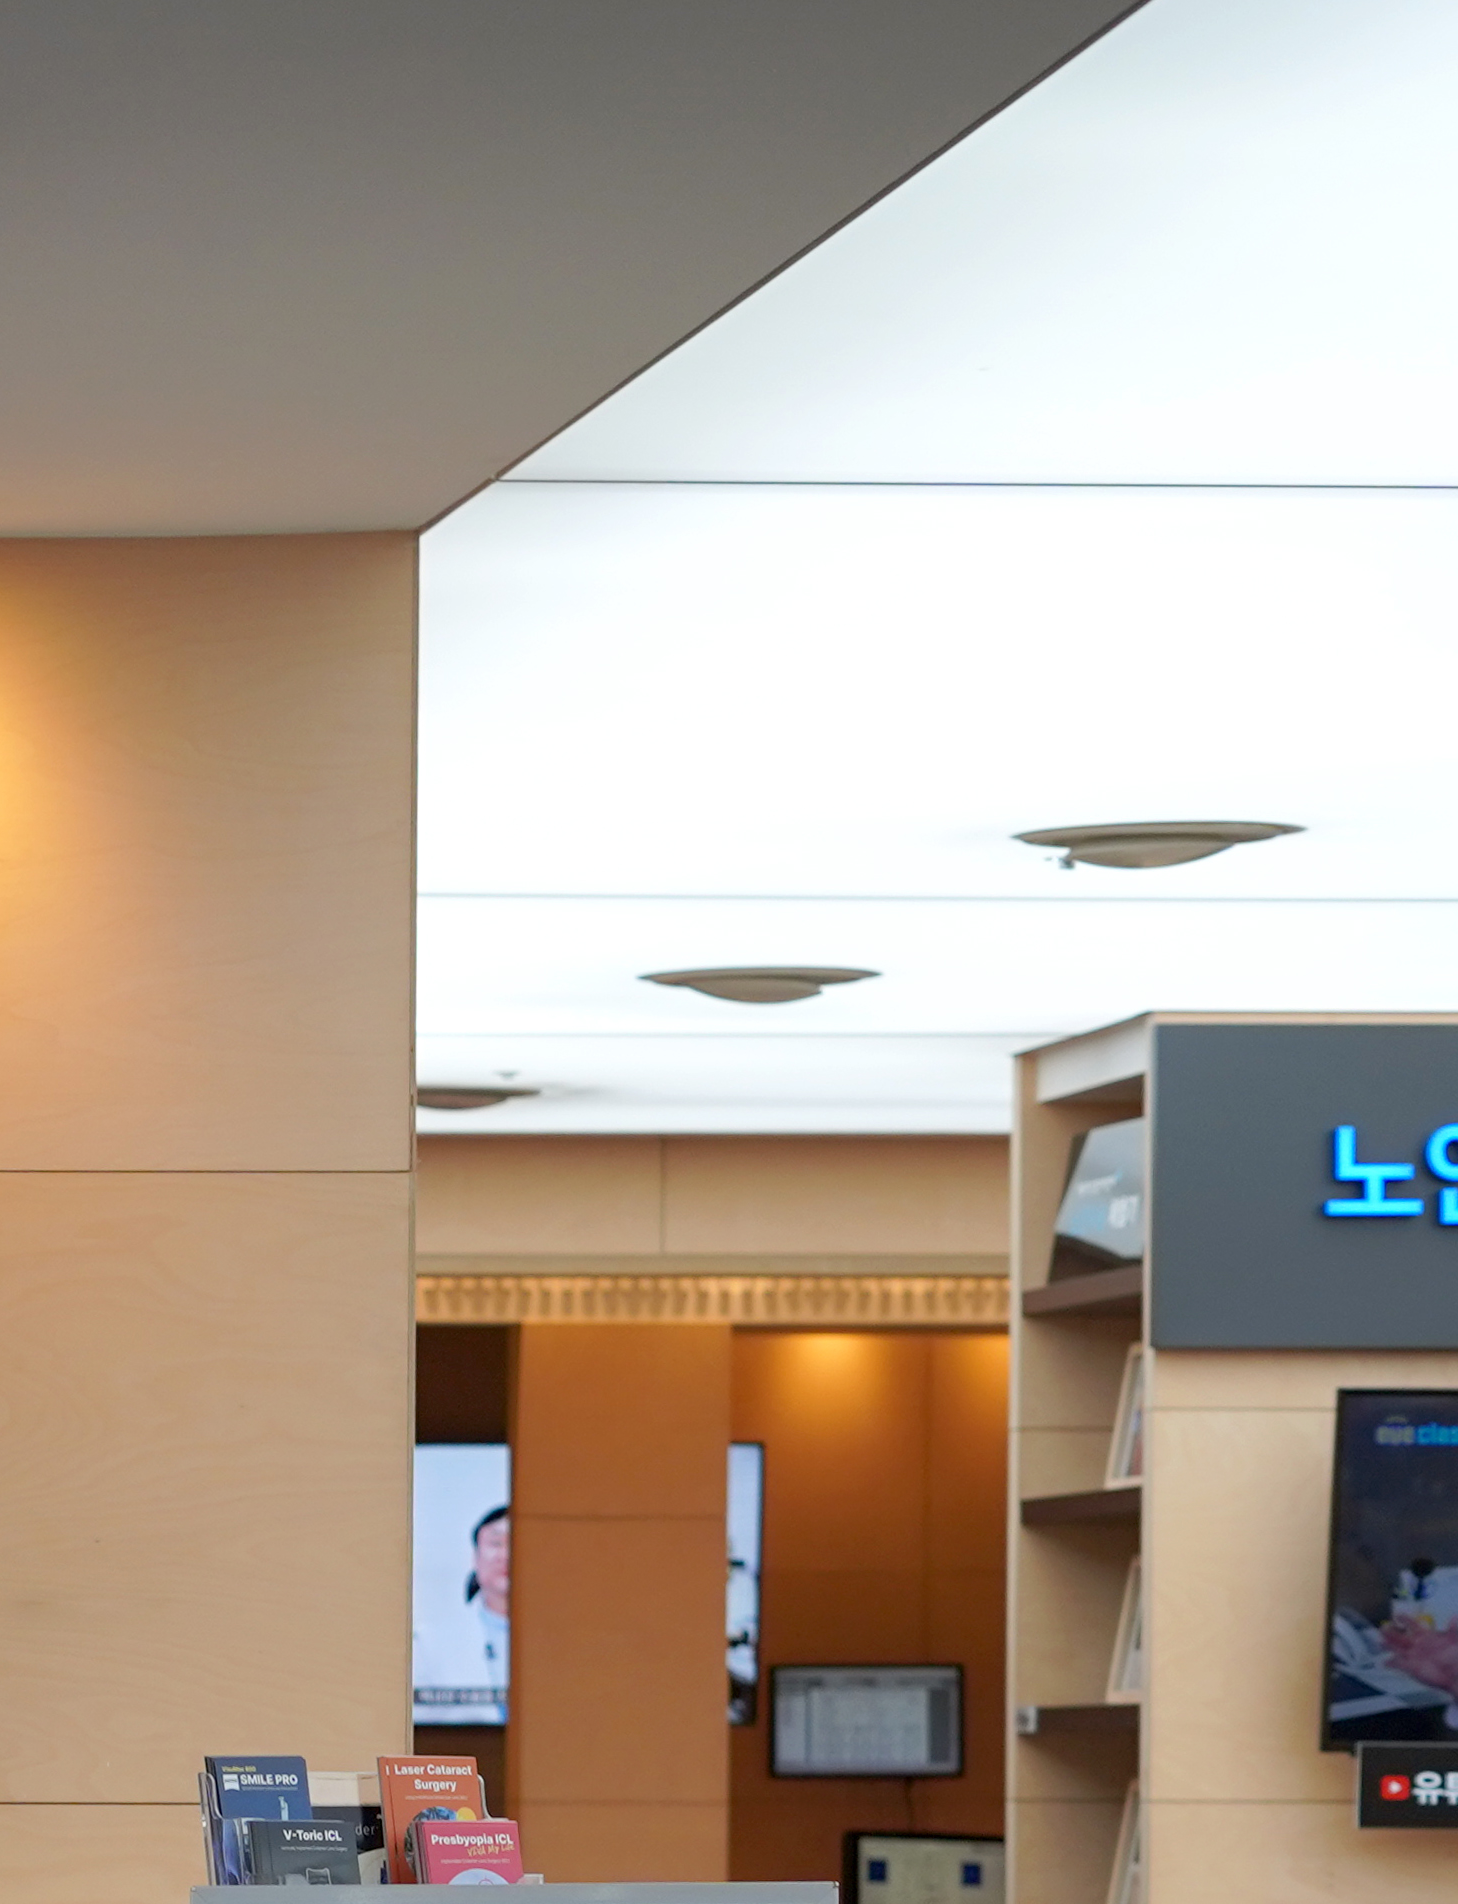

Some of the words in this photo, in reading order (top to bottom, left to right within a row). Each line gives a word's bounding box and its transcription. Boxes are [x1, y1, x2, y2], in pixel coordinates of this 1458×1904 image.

[394, 1763, 425, 1776] Laser
[426, 1763, 474, 1777] Cataract
[239, 1773, 273, 1785] SMILE
[275, 1774, 299, 1786] PRO
[414, 1778, 458, 1793] Surgery
[324, 1829, 343, 1842] ICL
[430, 1833, 494, 1847] Presbyopia
[494, 1833, 515, 1845] ICL
